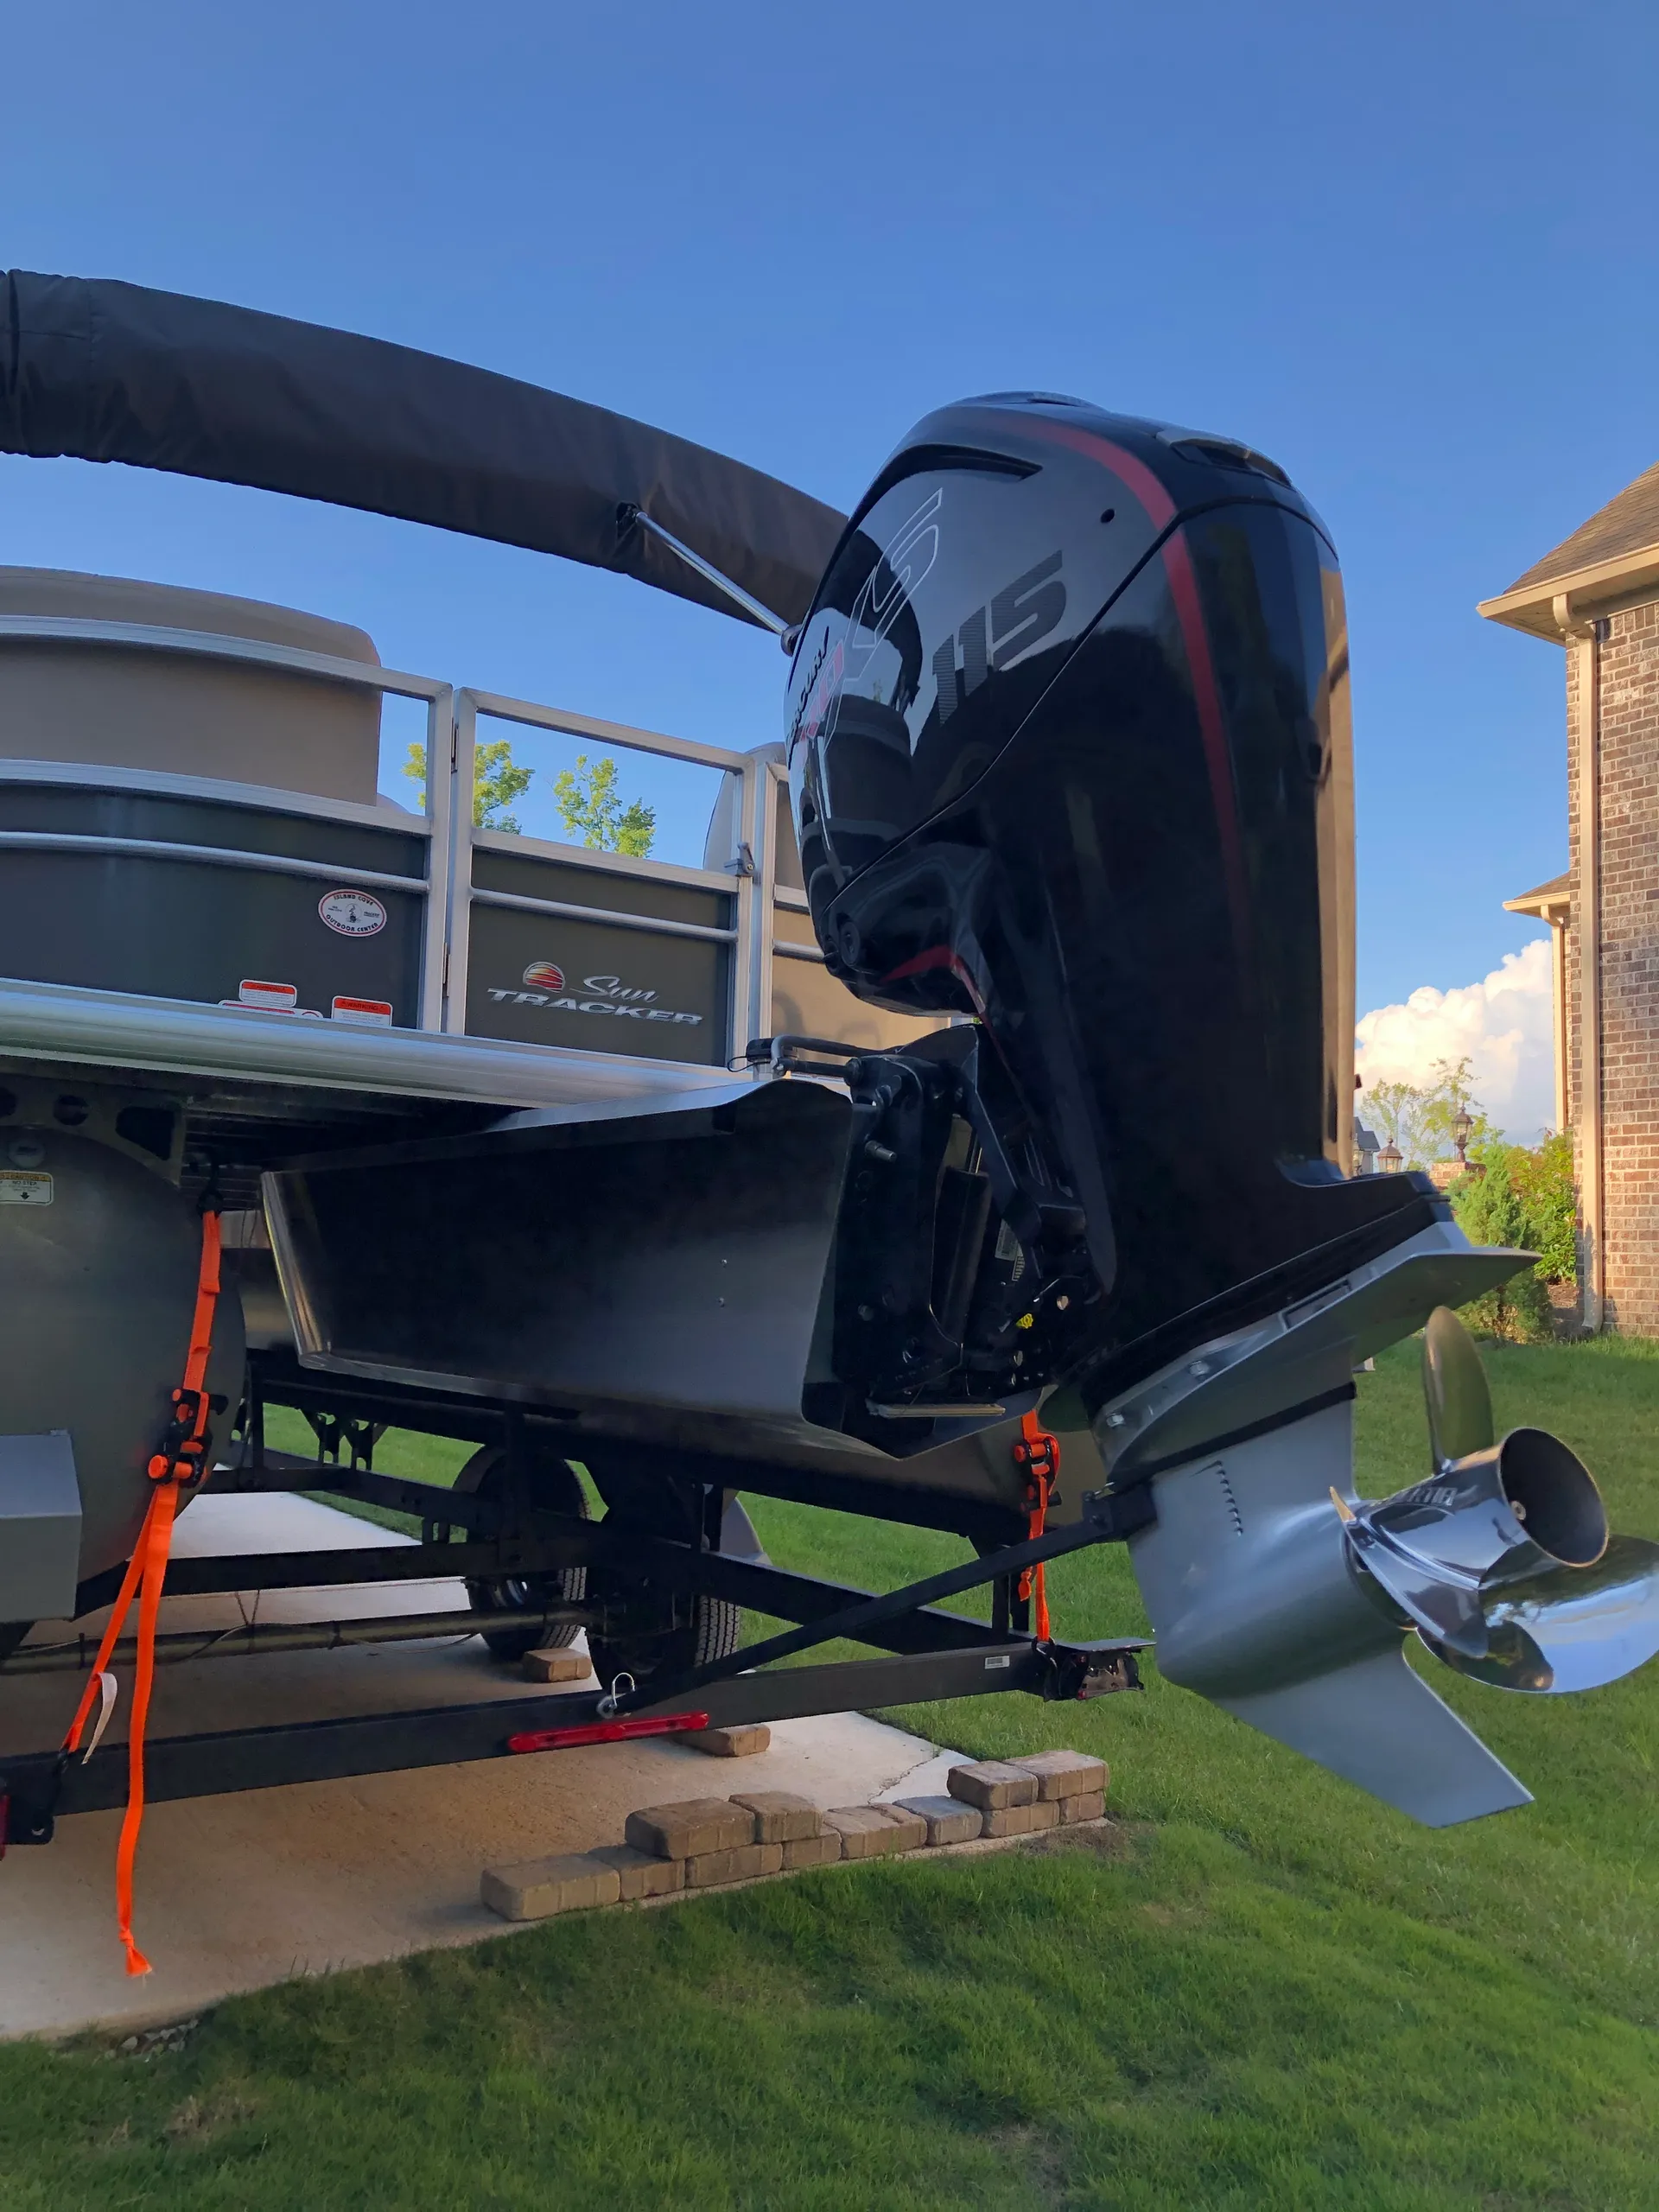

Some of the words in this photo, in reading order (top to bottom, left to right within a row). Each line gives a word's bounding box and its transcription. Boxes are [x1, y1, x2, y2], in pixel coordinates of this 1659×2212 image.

[932, 550, 1066, 726] 115
[326, 914, 355, 932] OUTDOOR
[357, 922, 378, 932] CENTER
[569, 975, 659, 1003] Sun
[487, 987, 704, 1026] TRACKER
